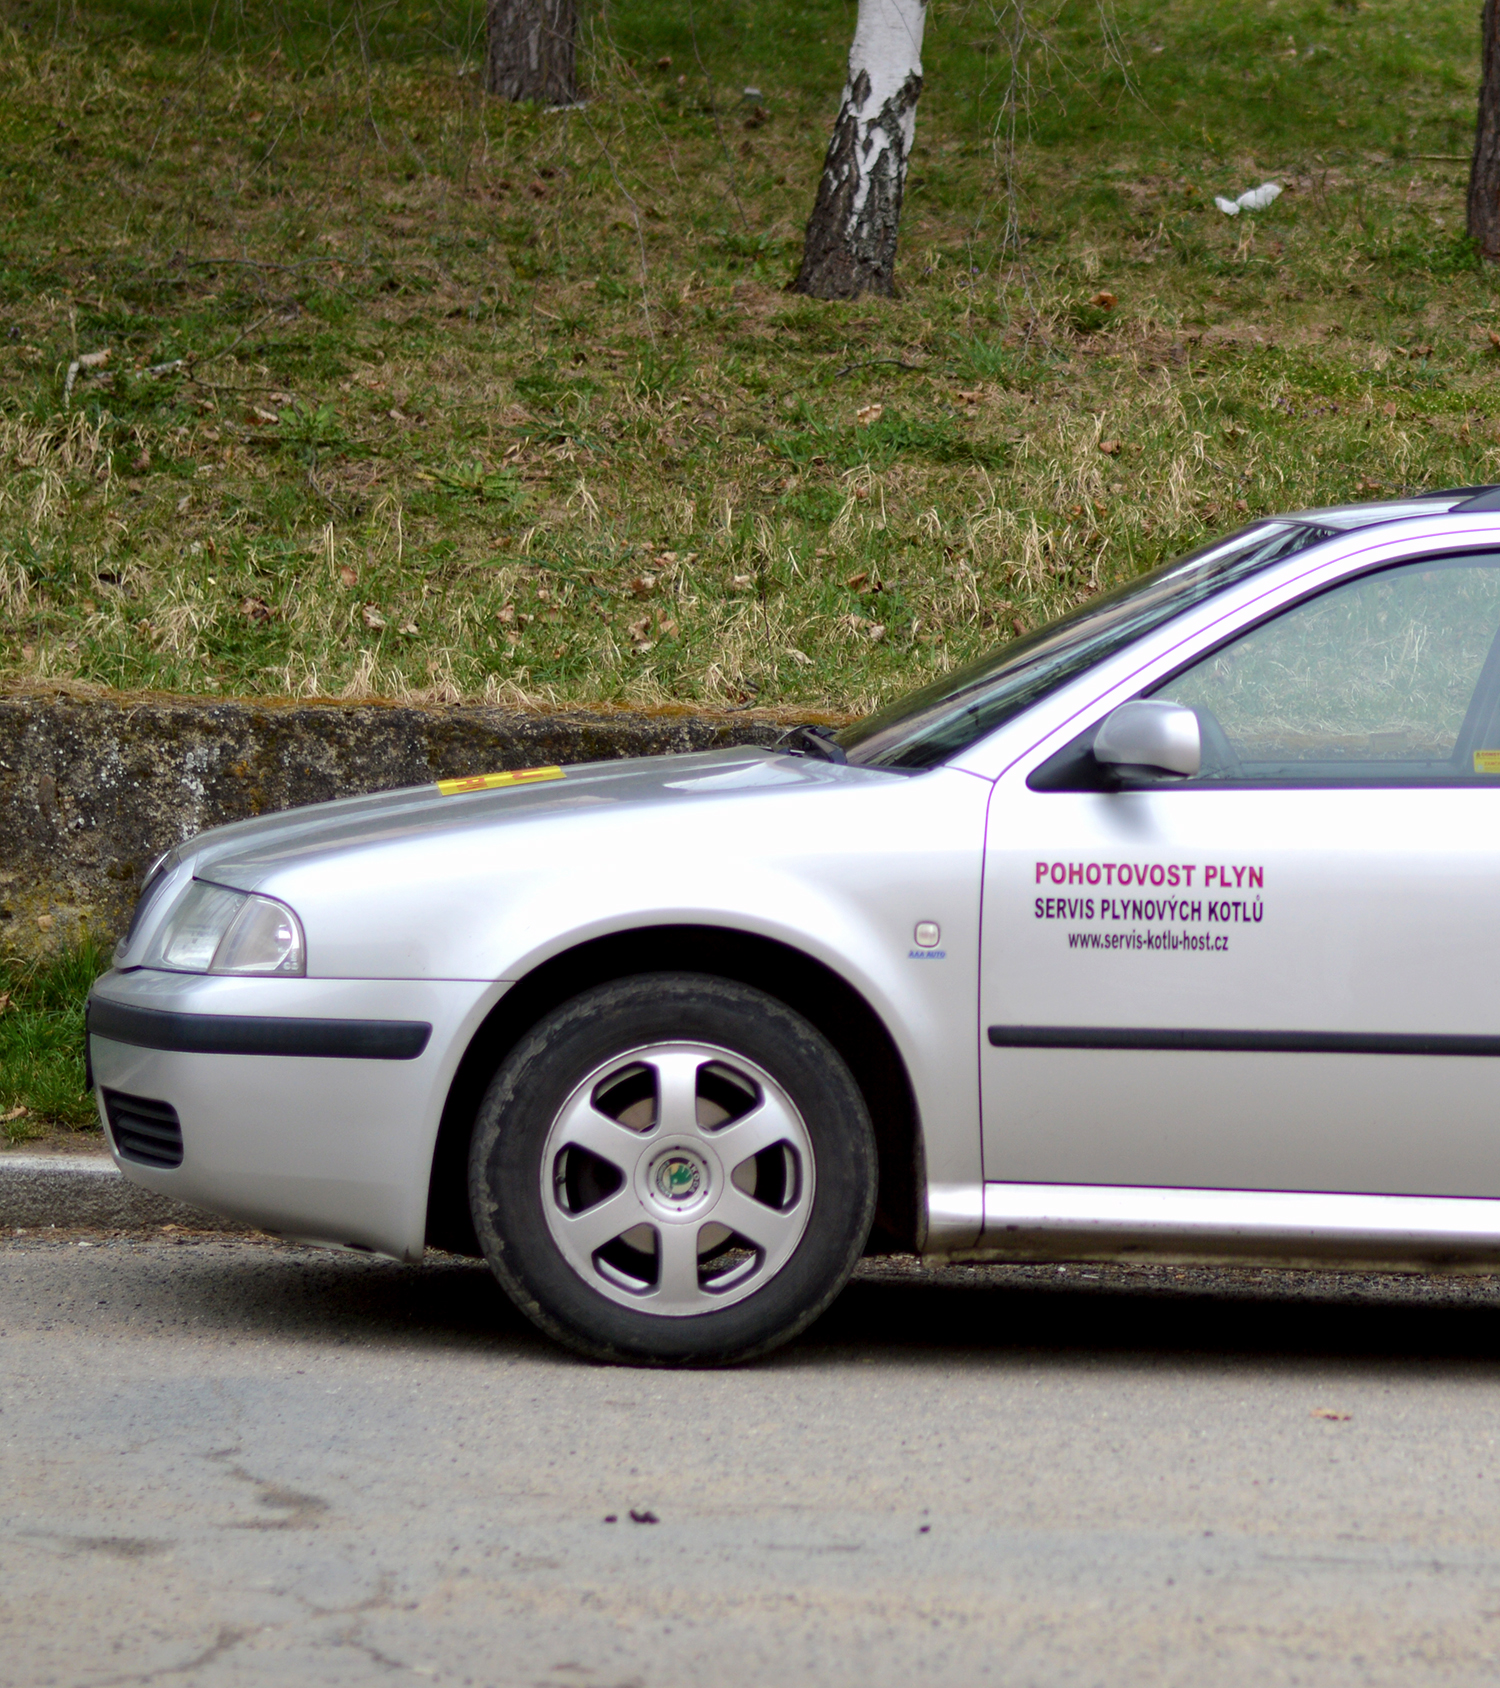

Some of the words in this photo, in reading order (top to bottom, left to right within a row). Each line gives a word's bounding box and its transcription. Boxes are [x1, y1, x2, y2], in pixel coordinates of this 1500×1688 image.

[1035, 861, 1197, 887] POHOTOVOST
[1204, 865, 1264, 888] PLYN
[1034, 897, 1095, 919] SERVIS
[1101, 894, 1201, 922] PLYNOVÝCH
[1208, 894, 1264, 923] KOTLŮ
[1068, 929, 1229, 951] www.servis-kotlu-host.cz
